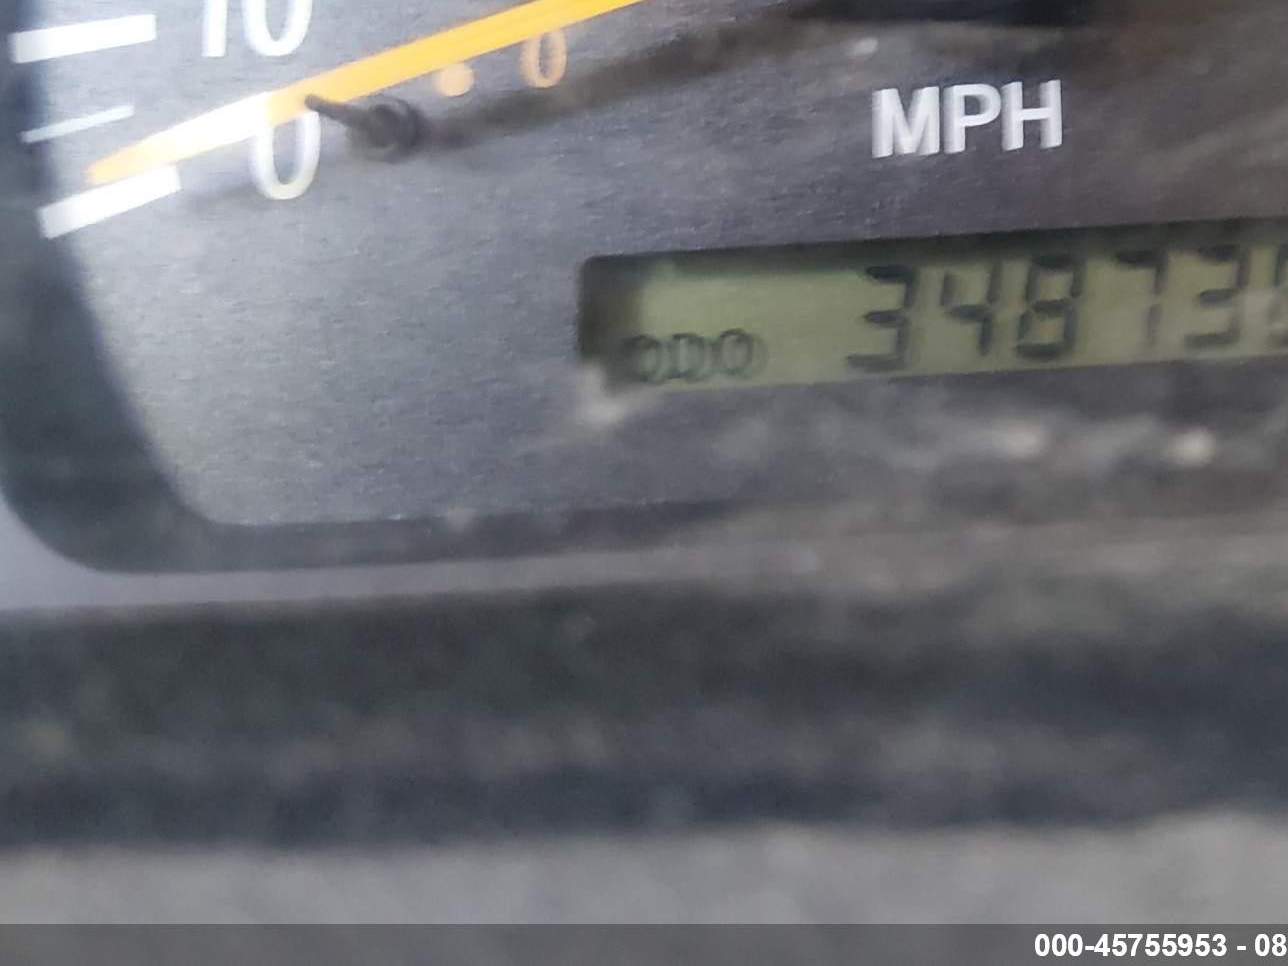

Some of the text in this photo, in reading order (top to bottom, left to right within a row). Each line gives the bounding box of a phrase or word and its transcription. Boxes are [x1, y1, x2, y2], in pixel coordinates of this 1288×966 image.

[520, 29, 567, 89] 0
[248, 110, 322, 201] 0
[871, 80, 1063, 159] MPH
